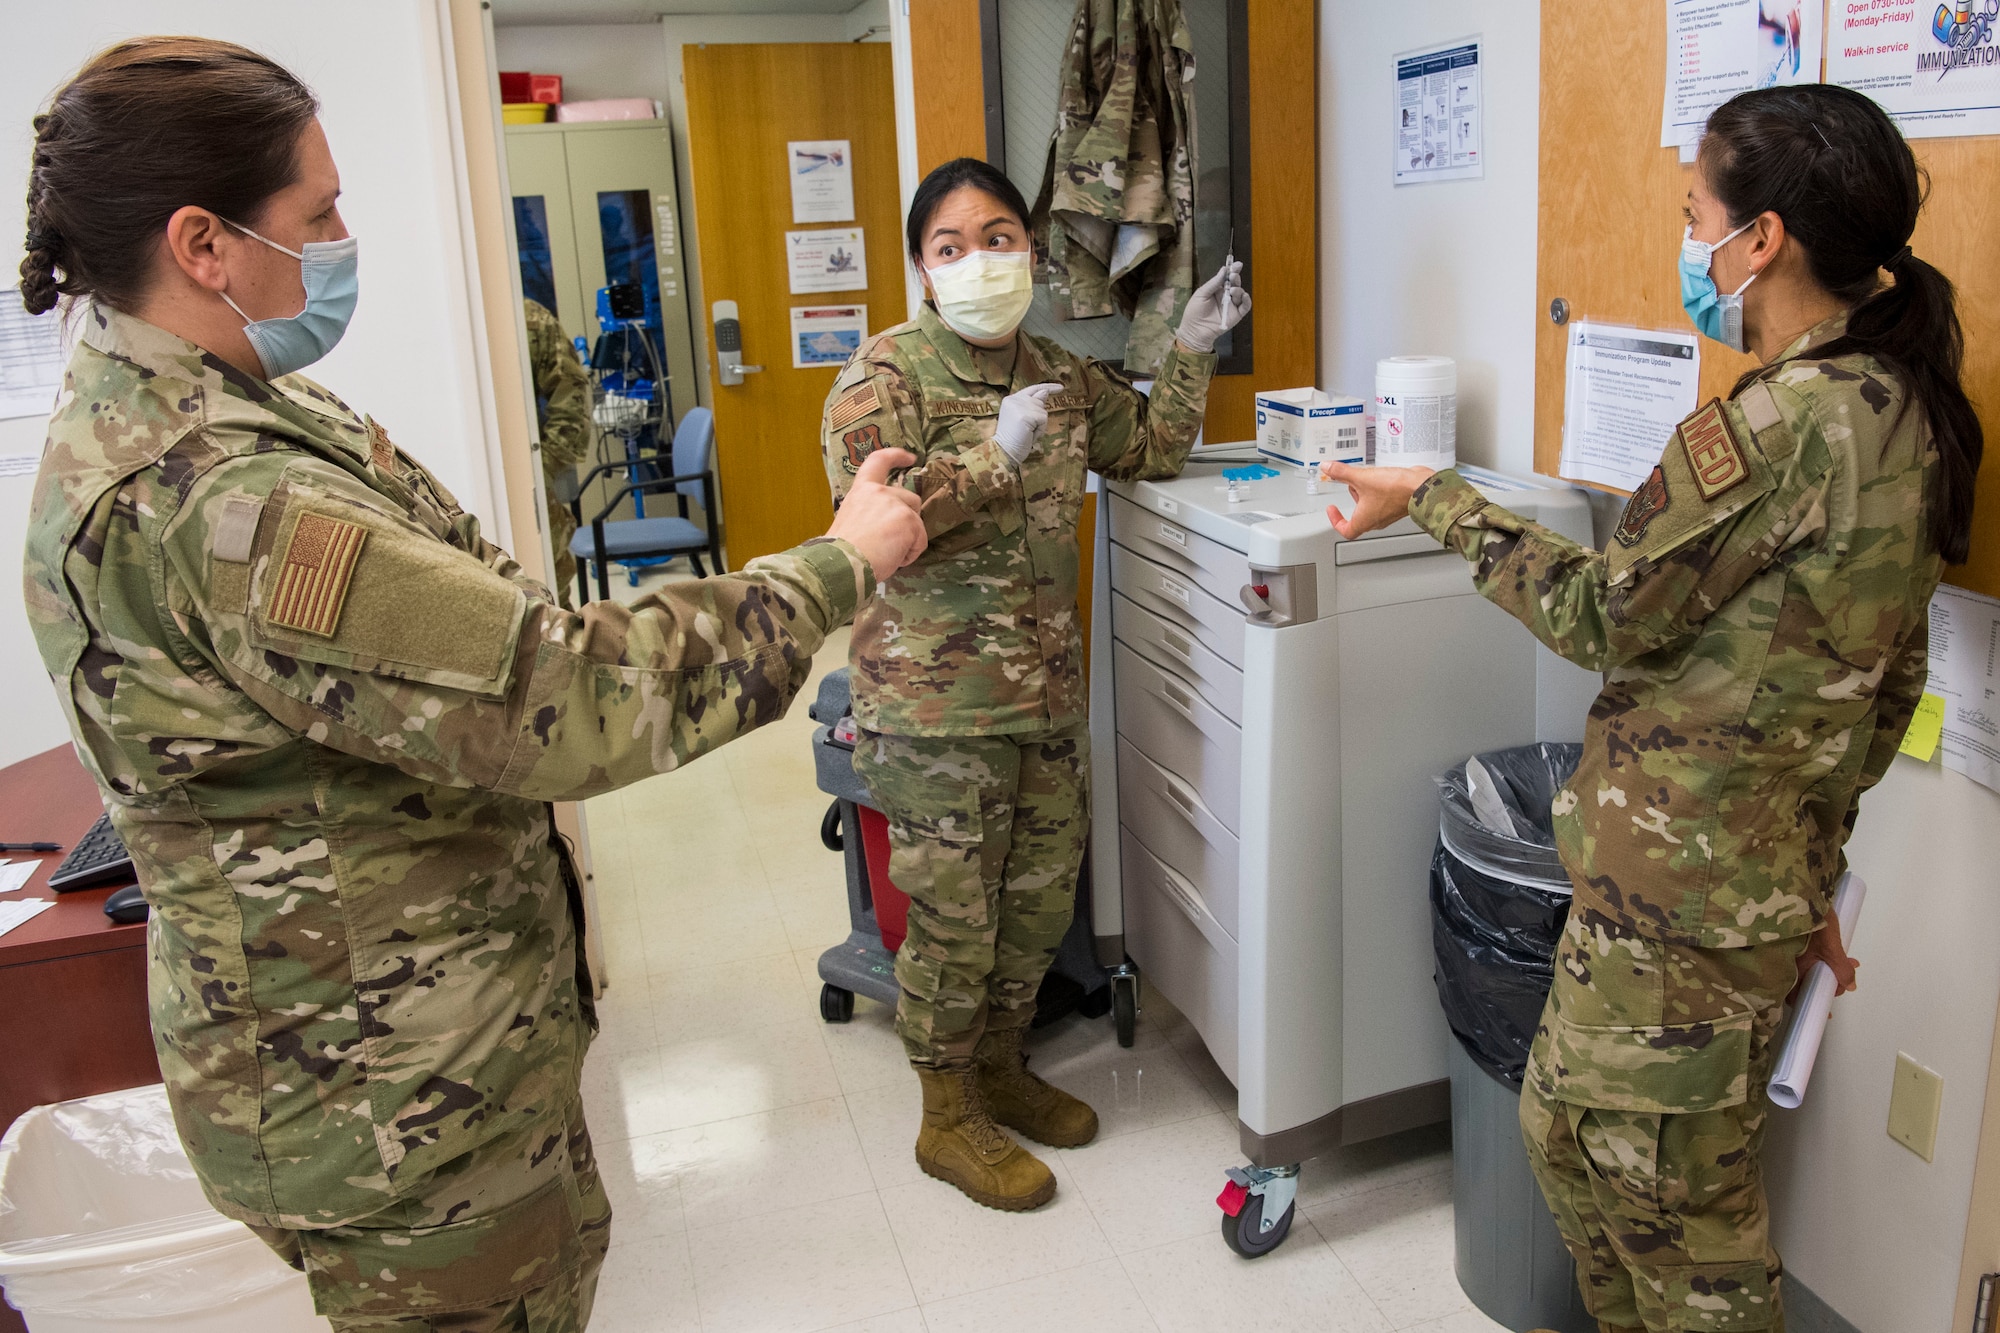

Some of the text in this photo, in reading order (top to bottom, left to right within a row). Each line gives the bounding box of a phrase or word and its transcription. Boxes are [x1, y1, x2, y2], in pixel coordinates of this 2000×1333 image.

[1847, 3, 1869, 15] Open
[1844, 9, 1914, 31] (Monday-Friday)
[1844, 42, 1909, 58] Walk-in service
[1594, 350, 1672, 368] Immunization Program Updates
[1634, 373, 1667, 383] Recommendation
[1667, 378, 1682, 386] Update
[935, 401, 994, 415] KINOSHITA
[1053, 396, 1067, 408] AIR
[1384, 396, 1397, 406] XL
[1684, 409, 1737, 486] MED
